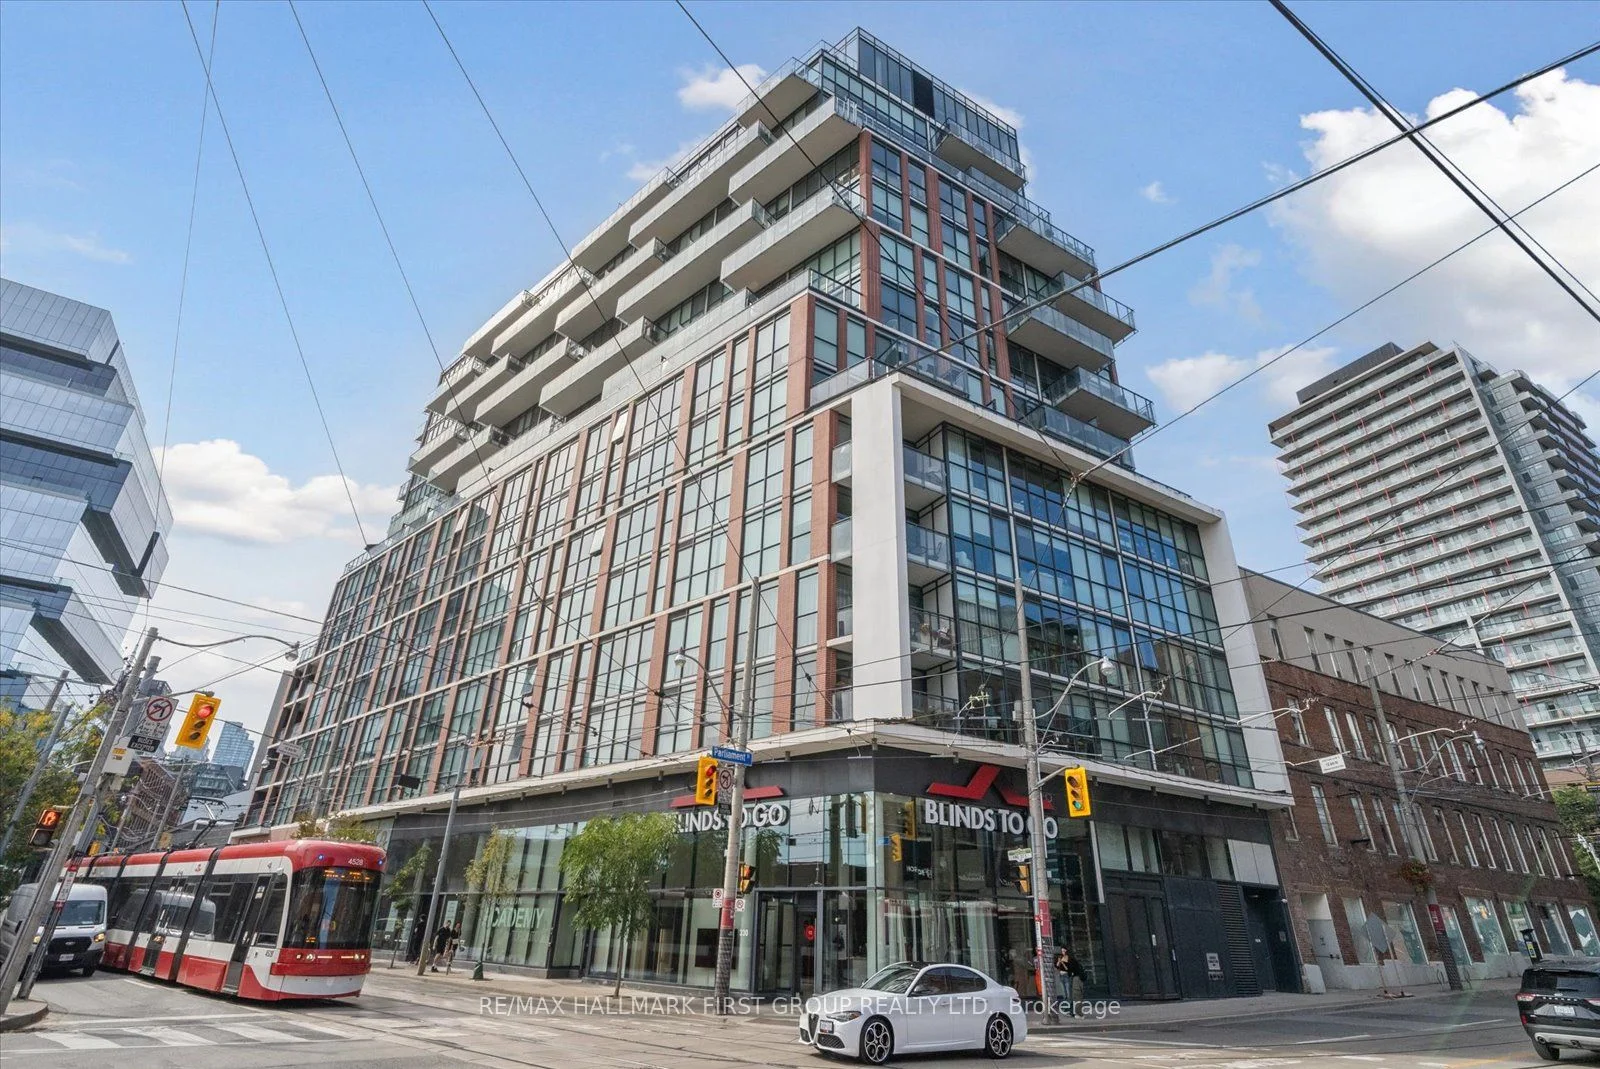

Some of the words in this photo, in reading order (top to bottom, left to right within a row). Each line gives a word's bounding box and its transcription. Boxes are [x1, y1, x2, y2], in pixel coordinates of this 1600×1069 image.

[713, 747, 746, 762] Parliament
[678, 809, 721, 833] LINDS
[752, 803, 783, 827] GO
[925, 799, 995, 831] BLINDS
[998, 809, 1024, 834] TO
